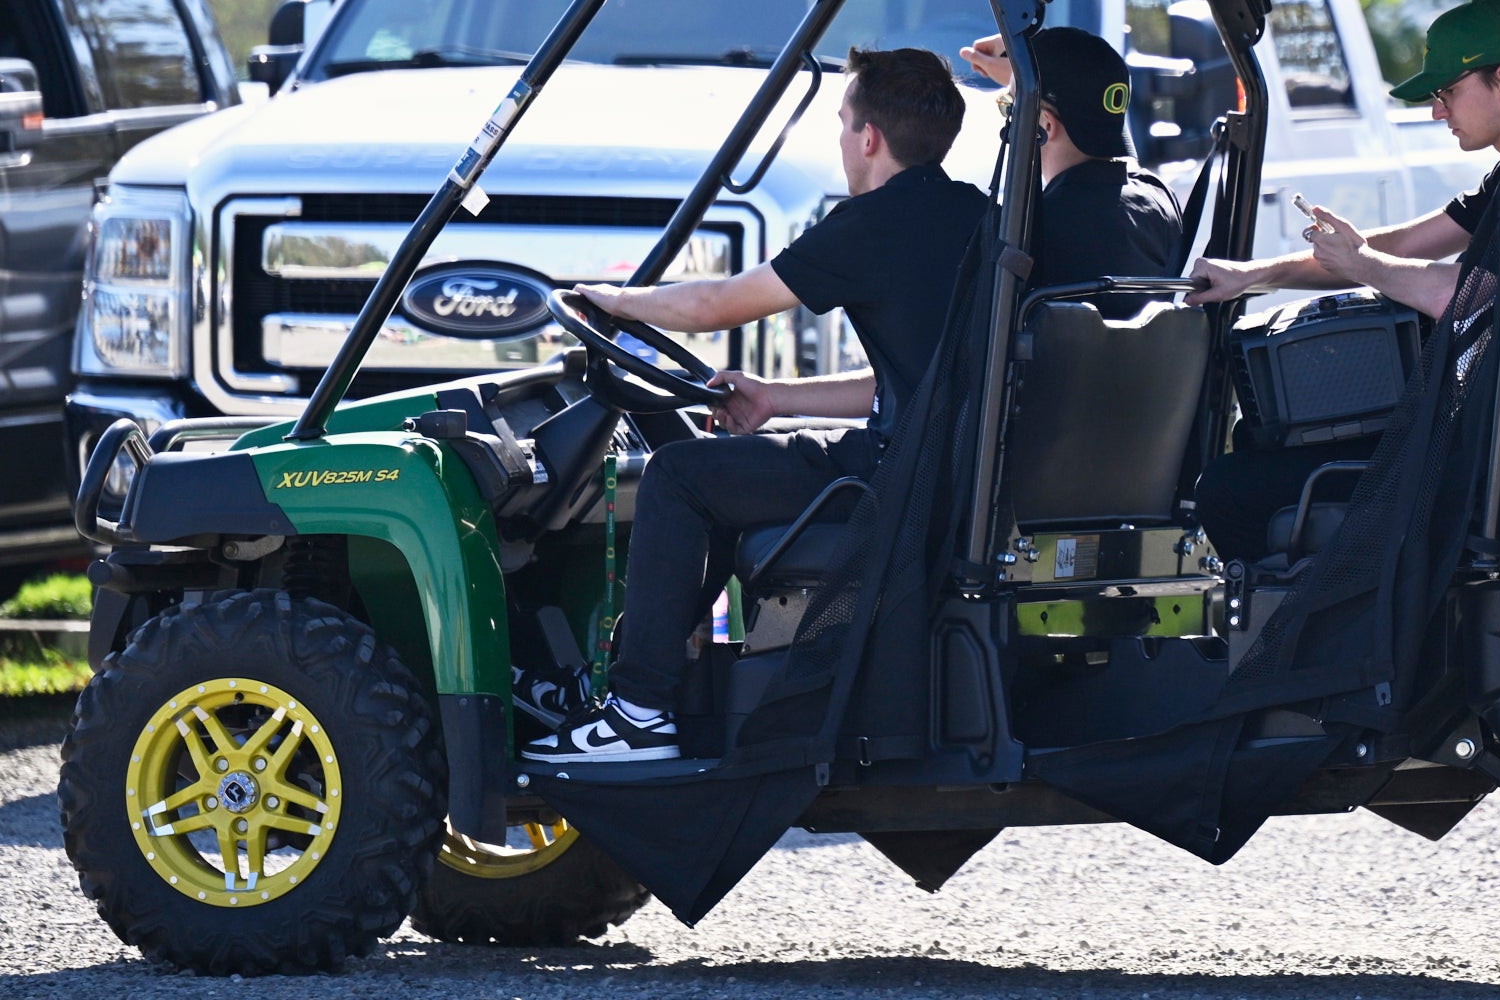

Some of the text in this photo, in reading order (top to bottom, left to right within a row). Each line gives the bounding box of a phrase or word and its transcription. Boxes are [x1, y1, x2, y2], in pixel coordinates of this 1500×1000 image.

[433, 277, 519, 317] Ford
[276, 468, 400, 489] XUV825M S4
